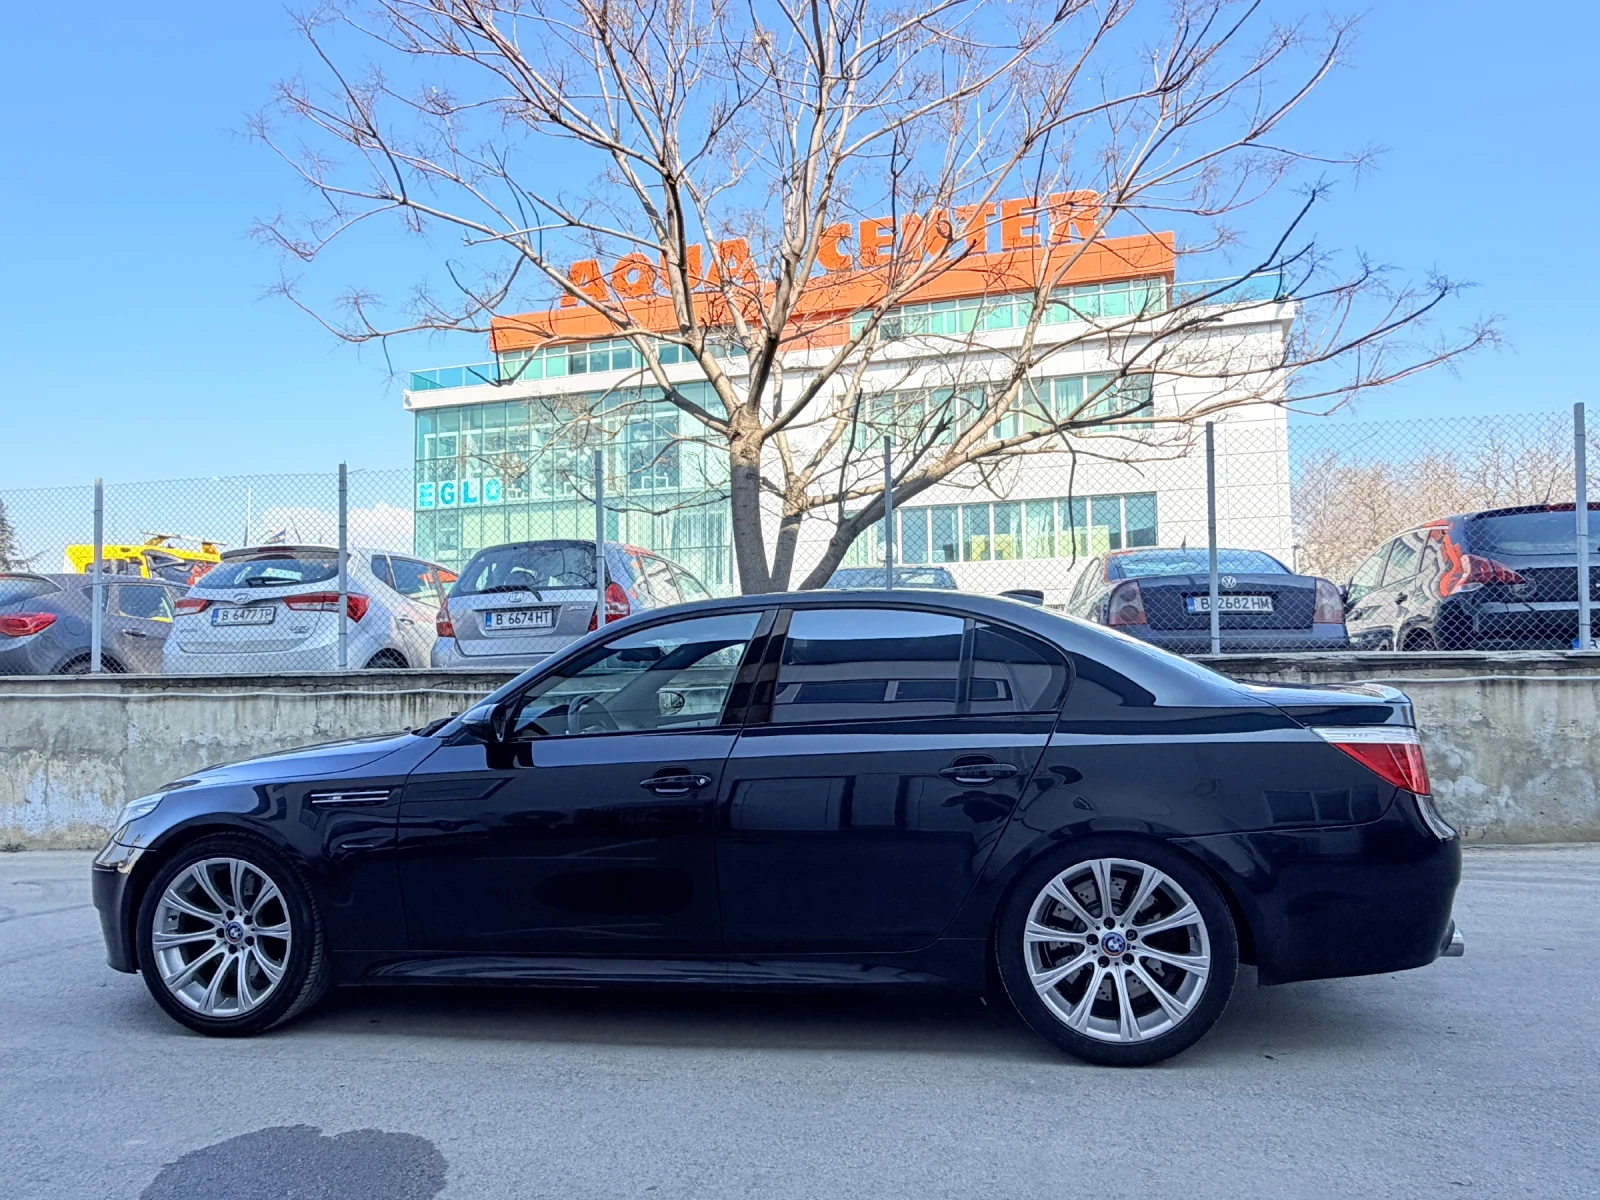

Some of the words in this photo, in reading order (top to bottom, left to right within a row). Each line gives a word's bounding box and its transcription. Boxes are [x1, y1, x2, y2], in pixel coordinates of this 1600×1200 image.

[560, 237, 761, 307] AQUA
[817, 189, 1105, 271] CENTER
[419, 479, 501, 507] EGLO
[496, 613, 503, 625] B
